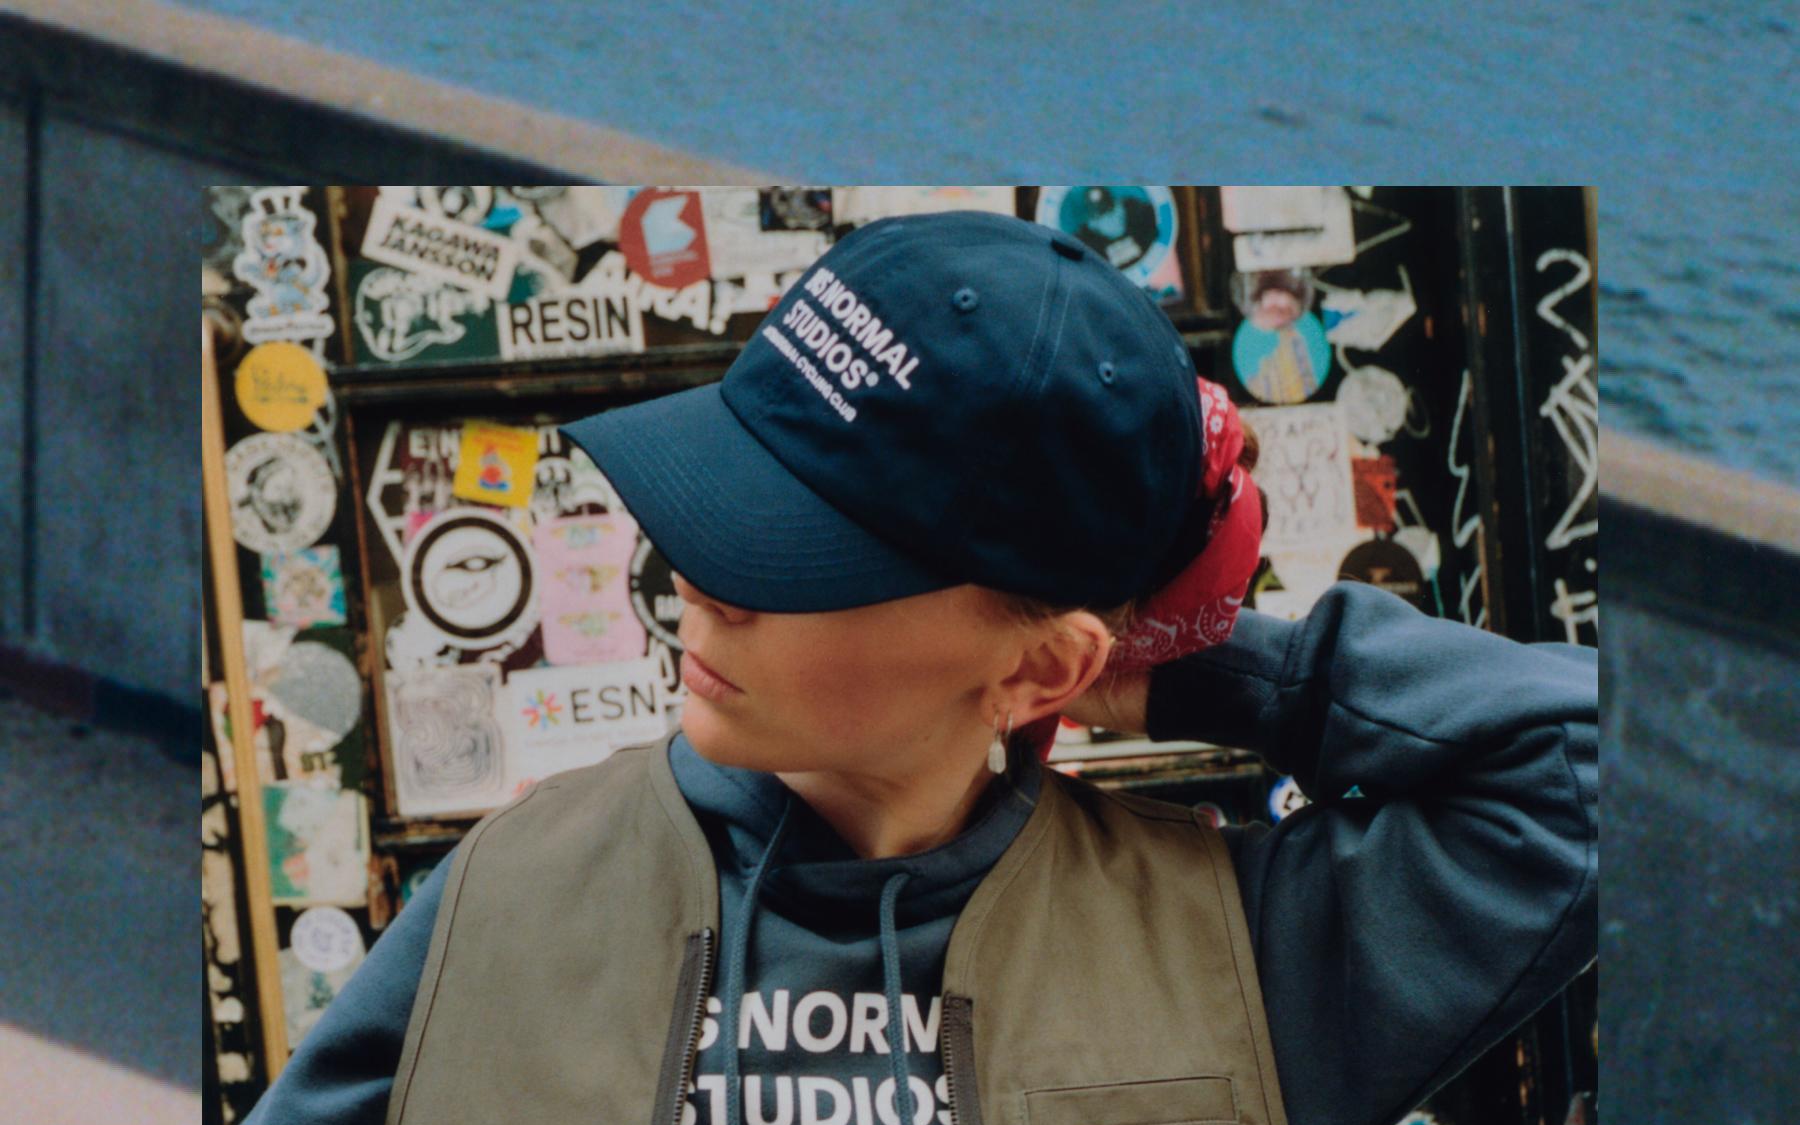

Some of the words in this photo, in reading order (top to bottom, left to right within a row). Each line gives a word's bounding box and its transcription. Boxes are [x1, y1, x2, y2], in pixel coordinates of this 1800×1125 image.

[509, 297, 630, 345] RESIN
[818, 279, 920, 390] NORMAL
[570, 684, 656, 724] ESN
